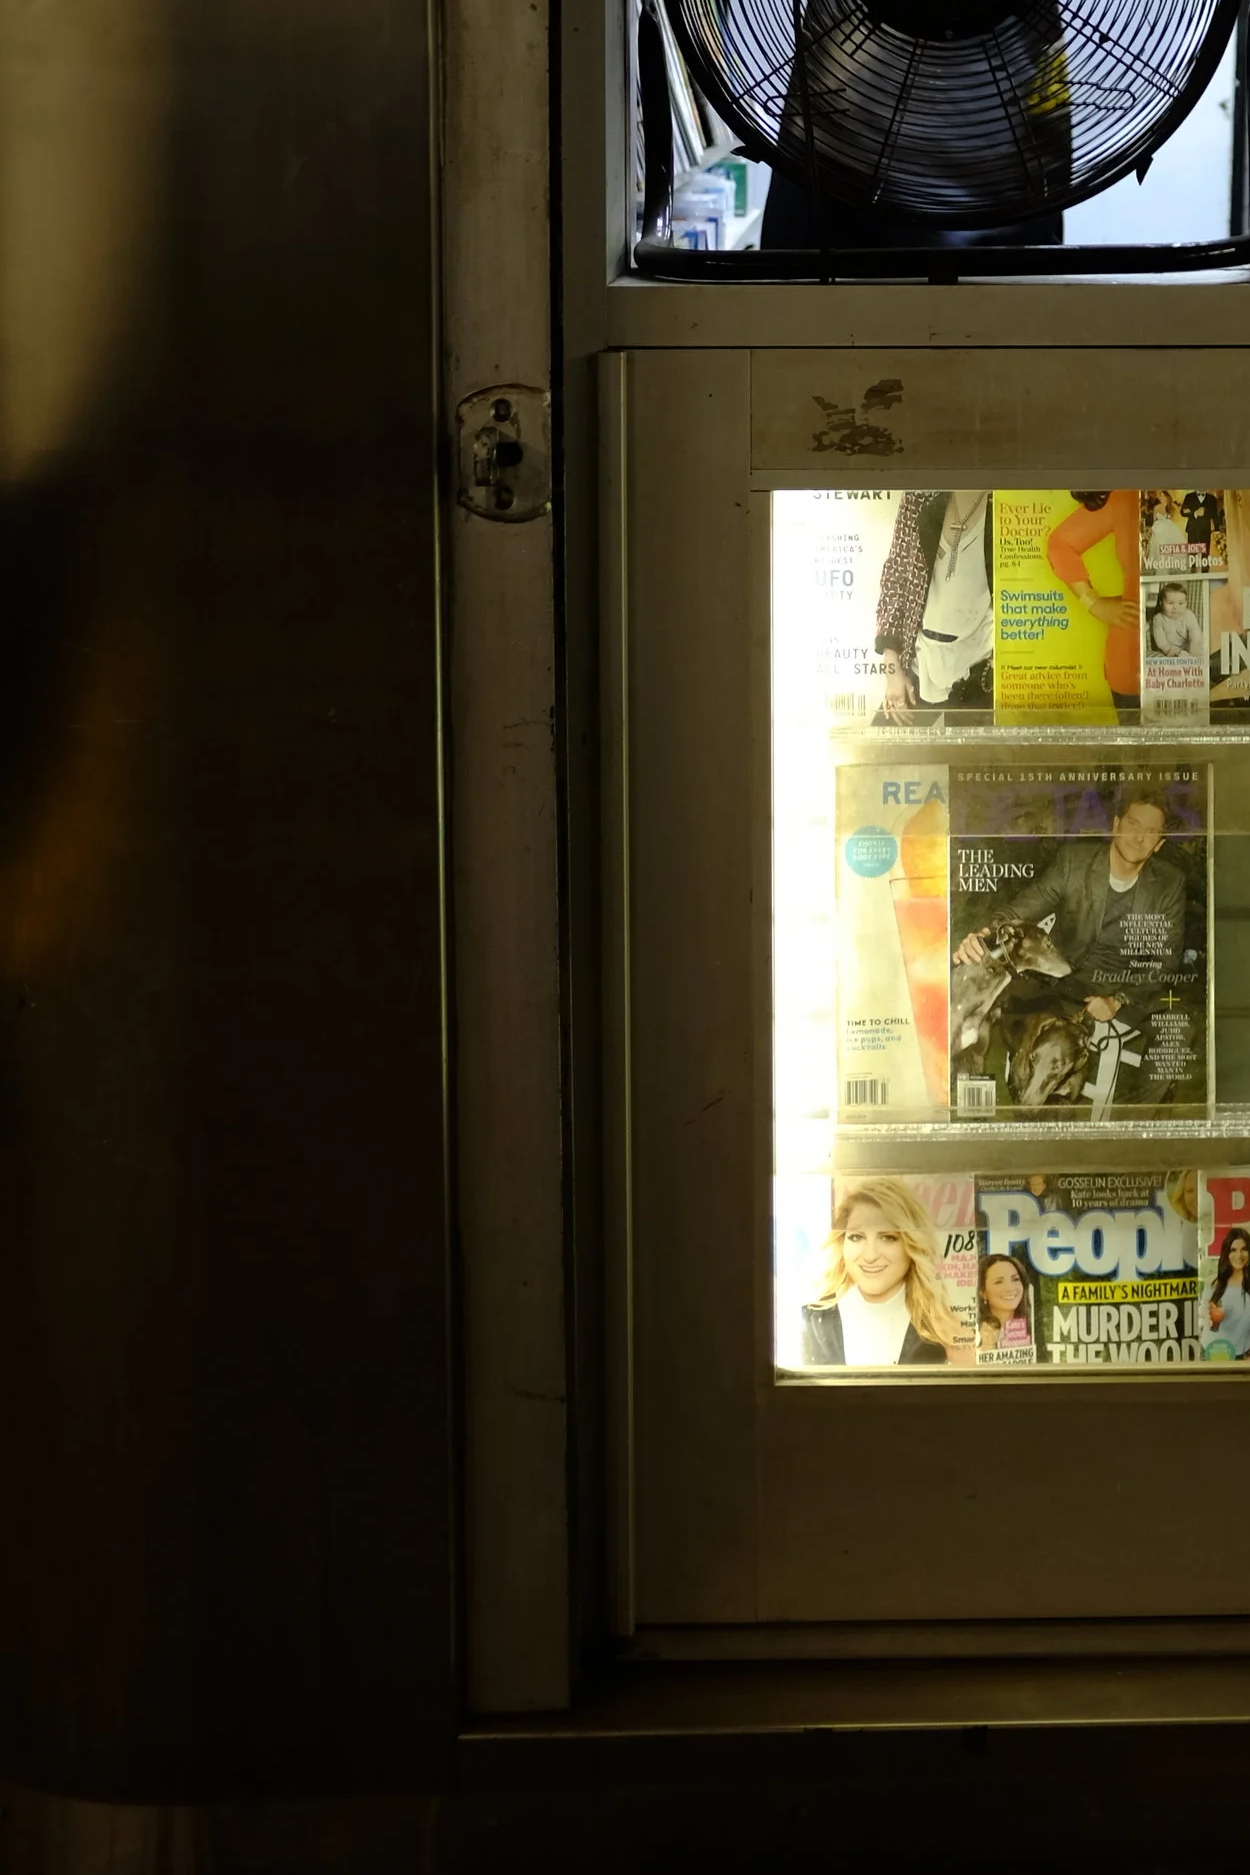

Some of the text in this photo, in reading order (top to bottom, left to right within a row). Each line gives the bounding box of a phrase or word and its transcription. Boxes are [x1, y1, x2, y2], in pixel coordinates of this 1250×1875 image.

[1032, 502, 1051, 514] Lie
[1000, 514, 1045, 526] to Your
[1160, 544, 1181, 554] SOFIA
[1144, 555, 1224, 571] Wedding Photos
[816, 569, 854, 587] UFO
[1001, 589, 1064, 601] Swimsuits
[1001, 603, 1067, 614] that make
[1001, 616, 1069, 630] everything
[1001, 628, 1044, 640] better!
[854, 663, 896, 675] STARS
[1147, 666, 1203, 678] At Home With
[1145, 677, 1205, 691] Baby Charlotte
[958, 771, 1199, 781] SPECIAL 15TH ANNIVERSARY ISSUE
[882, 781, 945, 805] REA
[958, 849, 994, 863] THE
[958, 863, 1035, 878] LEADING
[958, 878, 998, 892] MEN
[1120, 920, 1173, 928] INFLUENTIAL
[1120, 948, 1172, 956] MILLENNIUM
[1128, 960, 1162, 970] Starring
[1091, 969, 1198, 986] Bradley Cooper
[847, 1019, 867, 1027] TIME
[869, 1018, 881, 1026] TO
[1058, 1176, 1162, 1189] GOSSELIN EXCLUSIVE!
[1071, 1190, 1138, 1198] Kate looks back
[1072, 1198, 1149, 1208] 10 years drama
[944, 1230, 976, 1258] 108
[1062, 1285, 1128, 1300] A FAMILY'S
[1053, 1301, 1178, 1342] MURDER
[979, 1347, 1034, 1363] HER AMAZING
